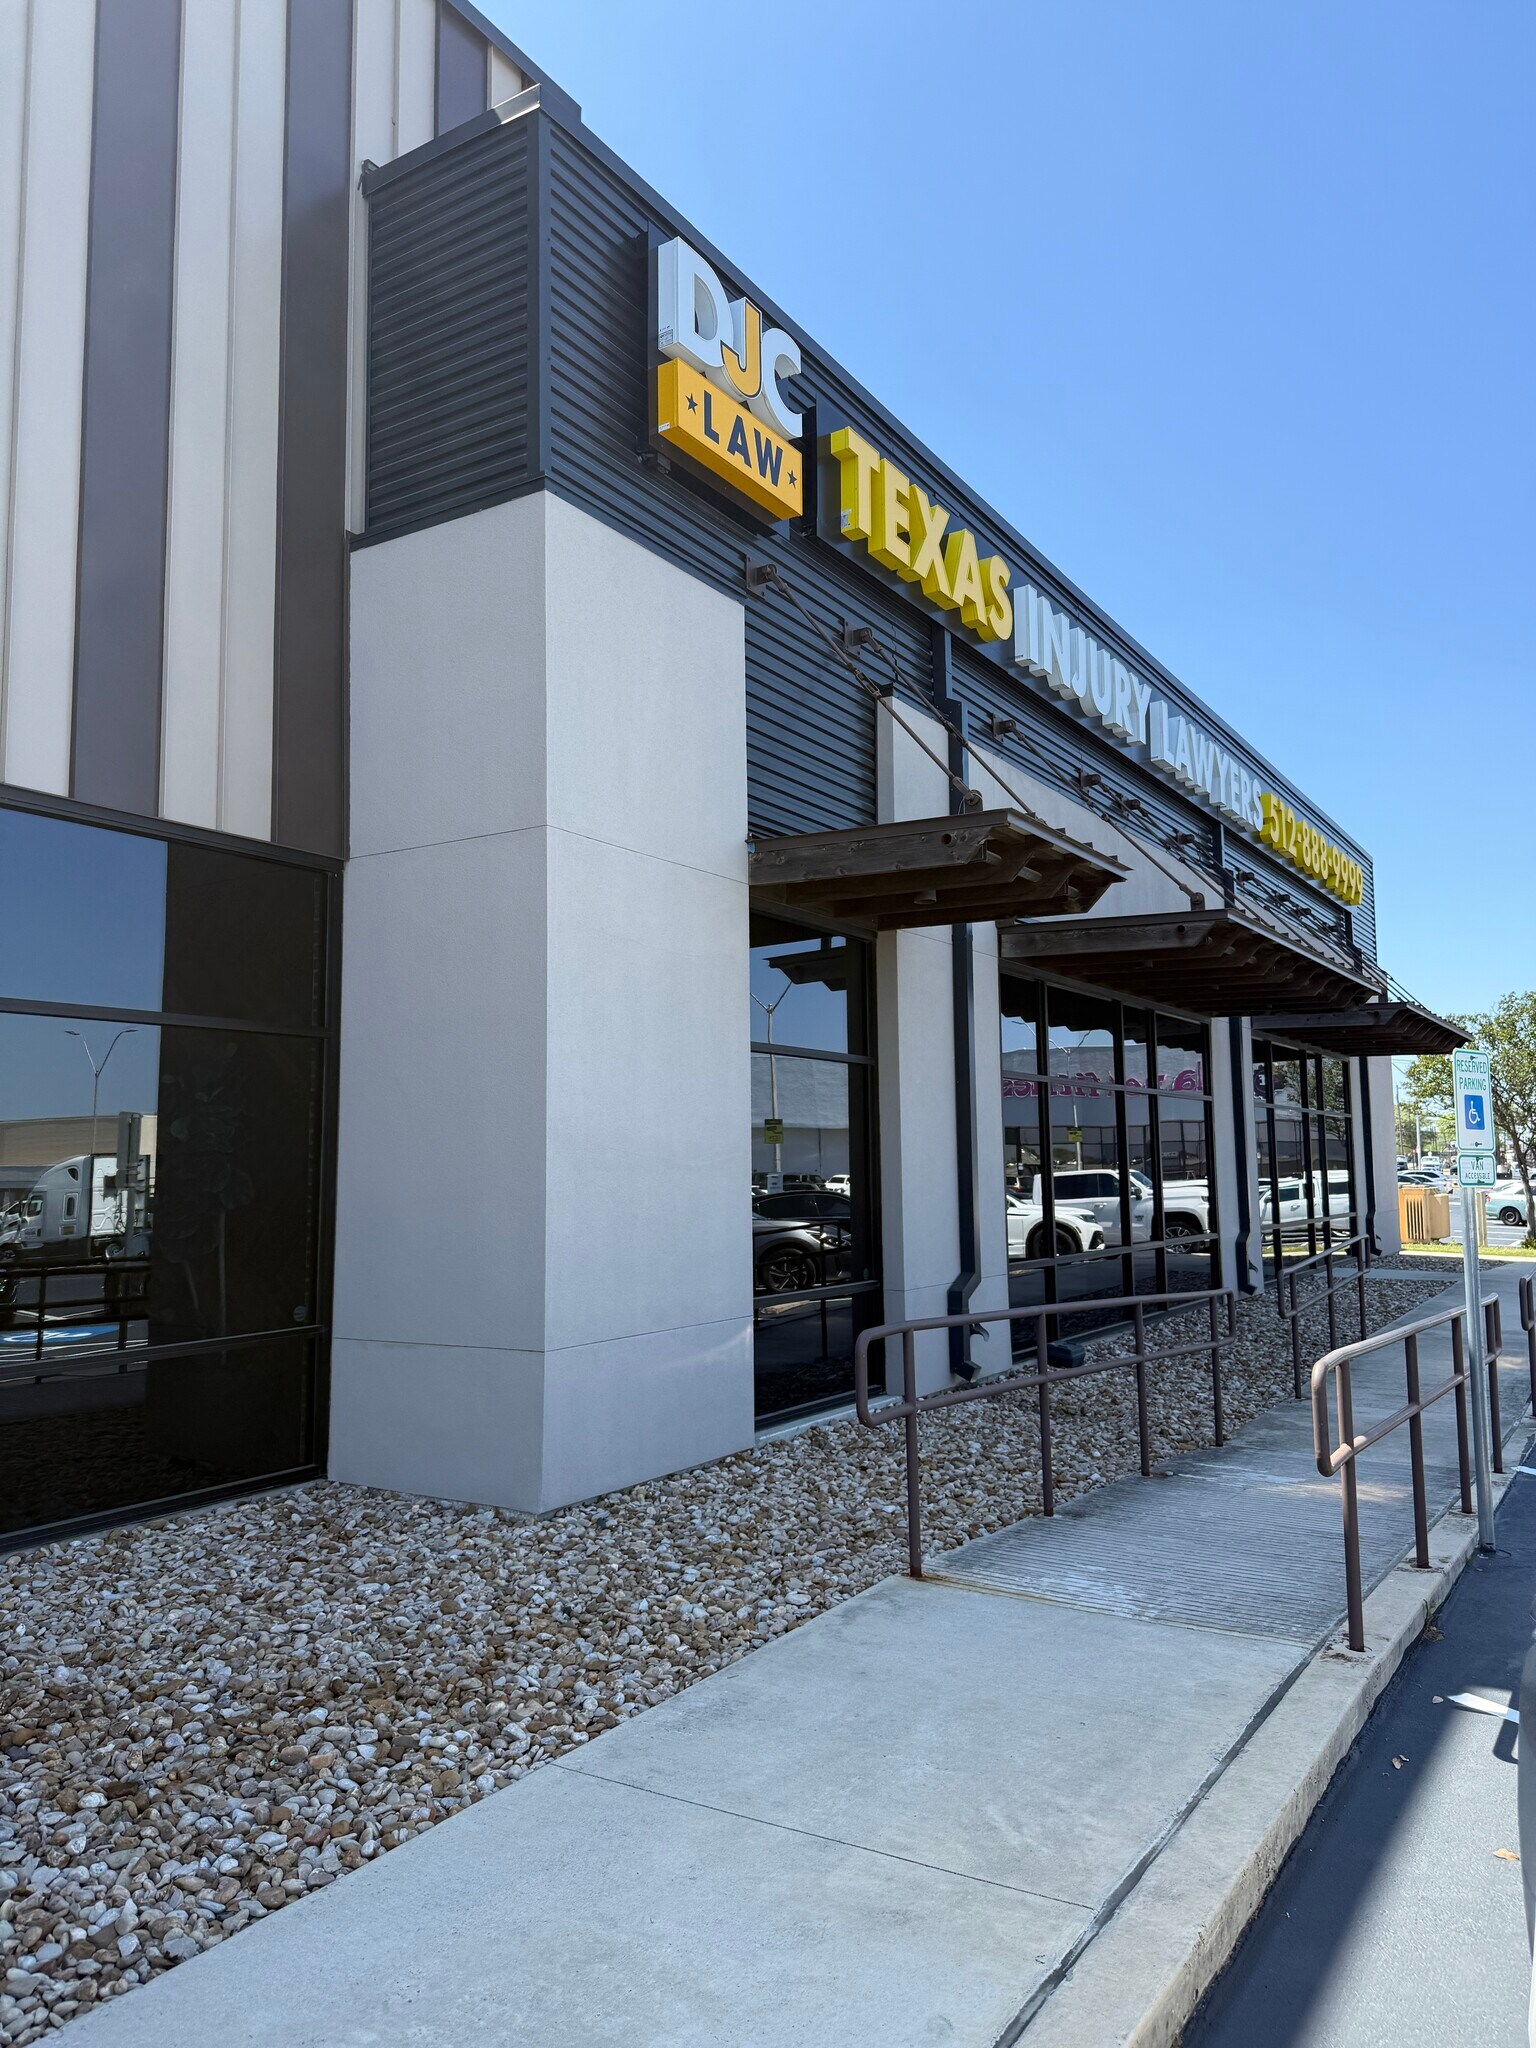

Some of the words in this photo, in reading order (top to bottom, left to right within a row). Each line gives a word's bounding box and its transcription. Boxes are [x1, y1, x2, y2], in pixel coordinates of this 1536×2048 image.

[660, 237, 802, 438] DJC
[703, 390, 783, 488] LAW
[831, 426, 1013, 641] TEXAS
[1014, 584, 1152, 746] INJURY
[1150, 700, 1264, 832] LAWYERS
[1260, 793, 1363, 905] 512-888-9999
[1456, 1060, 1488, 1074] RESERVED
[1459, 1077, 1487, 1091] PARKING
[1471, 1161, 1484, 1171] VAN
[1465, 1172, 1491, 1180] ACCESSIBLE
